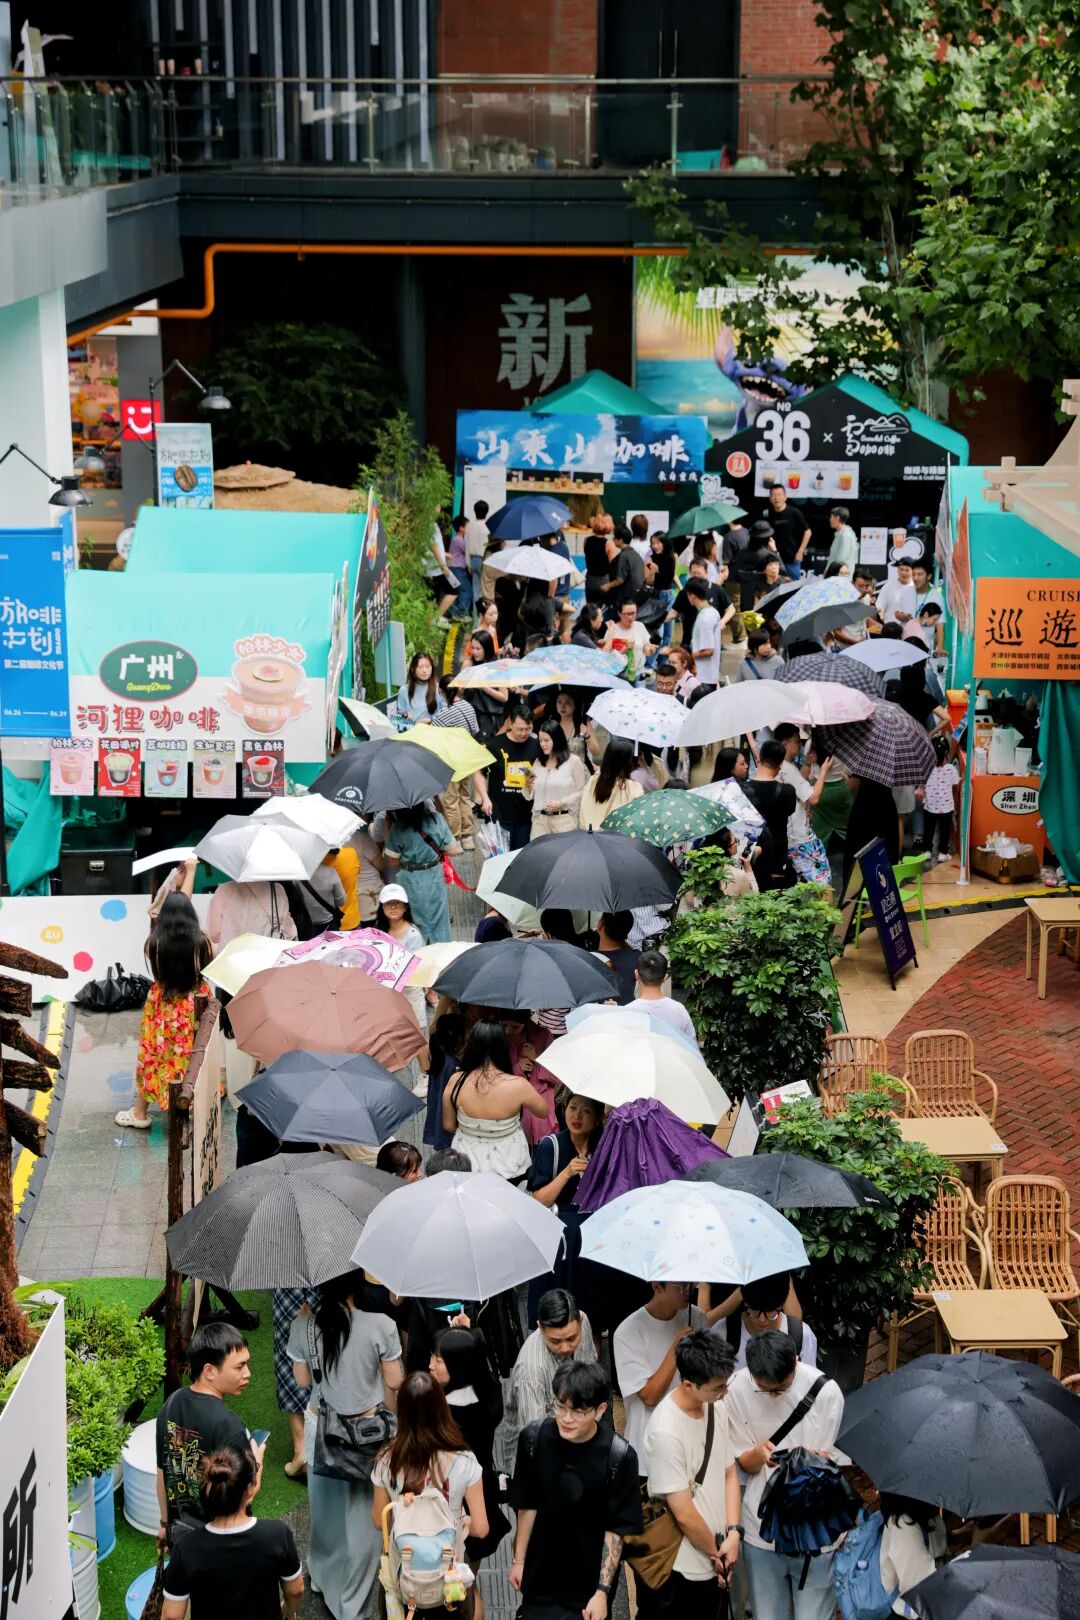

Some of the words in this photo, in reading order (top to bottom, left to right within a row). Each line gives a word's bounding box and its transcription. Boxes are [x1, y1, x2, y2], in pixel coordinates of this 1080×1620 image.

[497, 293, 593, 393] 新
[755, 410, 811, 461] 36
[119, 653, 174, 681] 广州
[126, 682, 172, 693] GuangZhou
[76, 704, 220, 734] 河狸咖啡
[1002, 791, 1036, 803] 深圳
